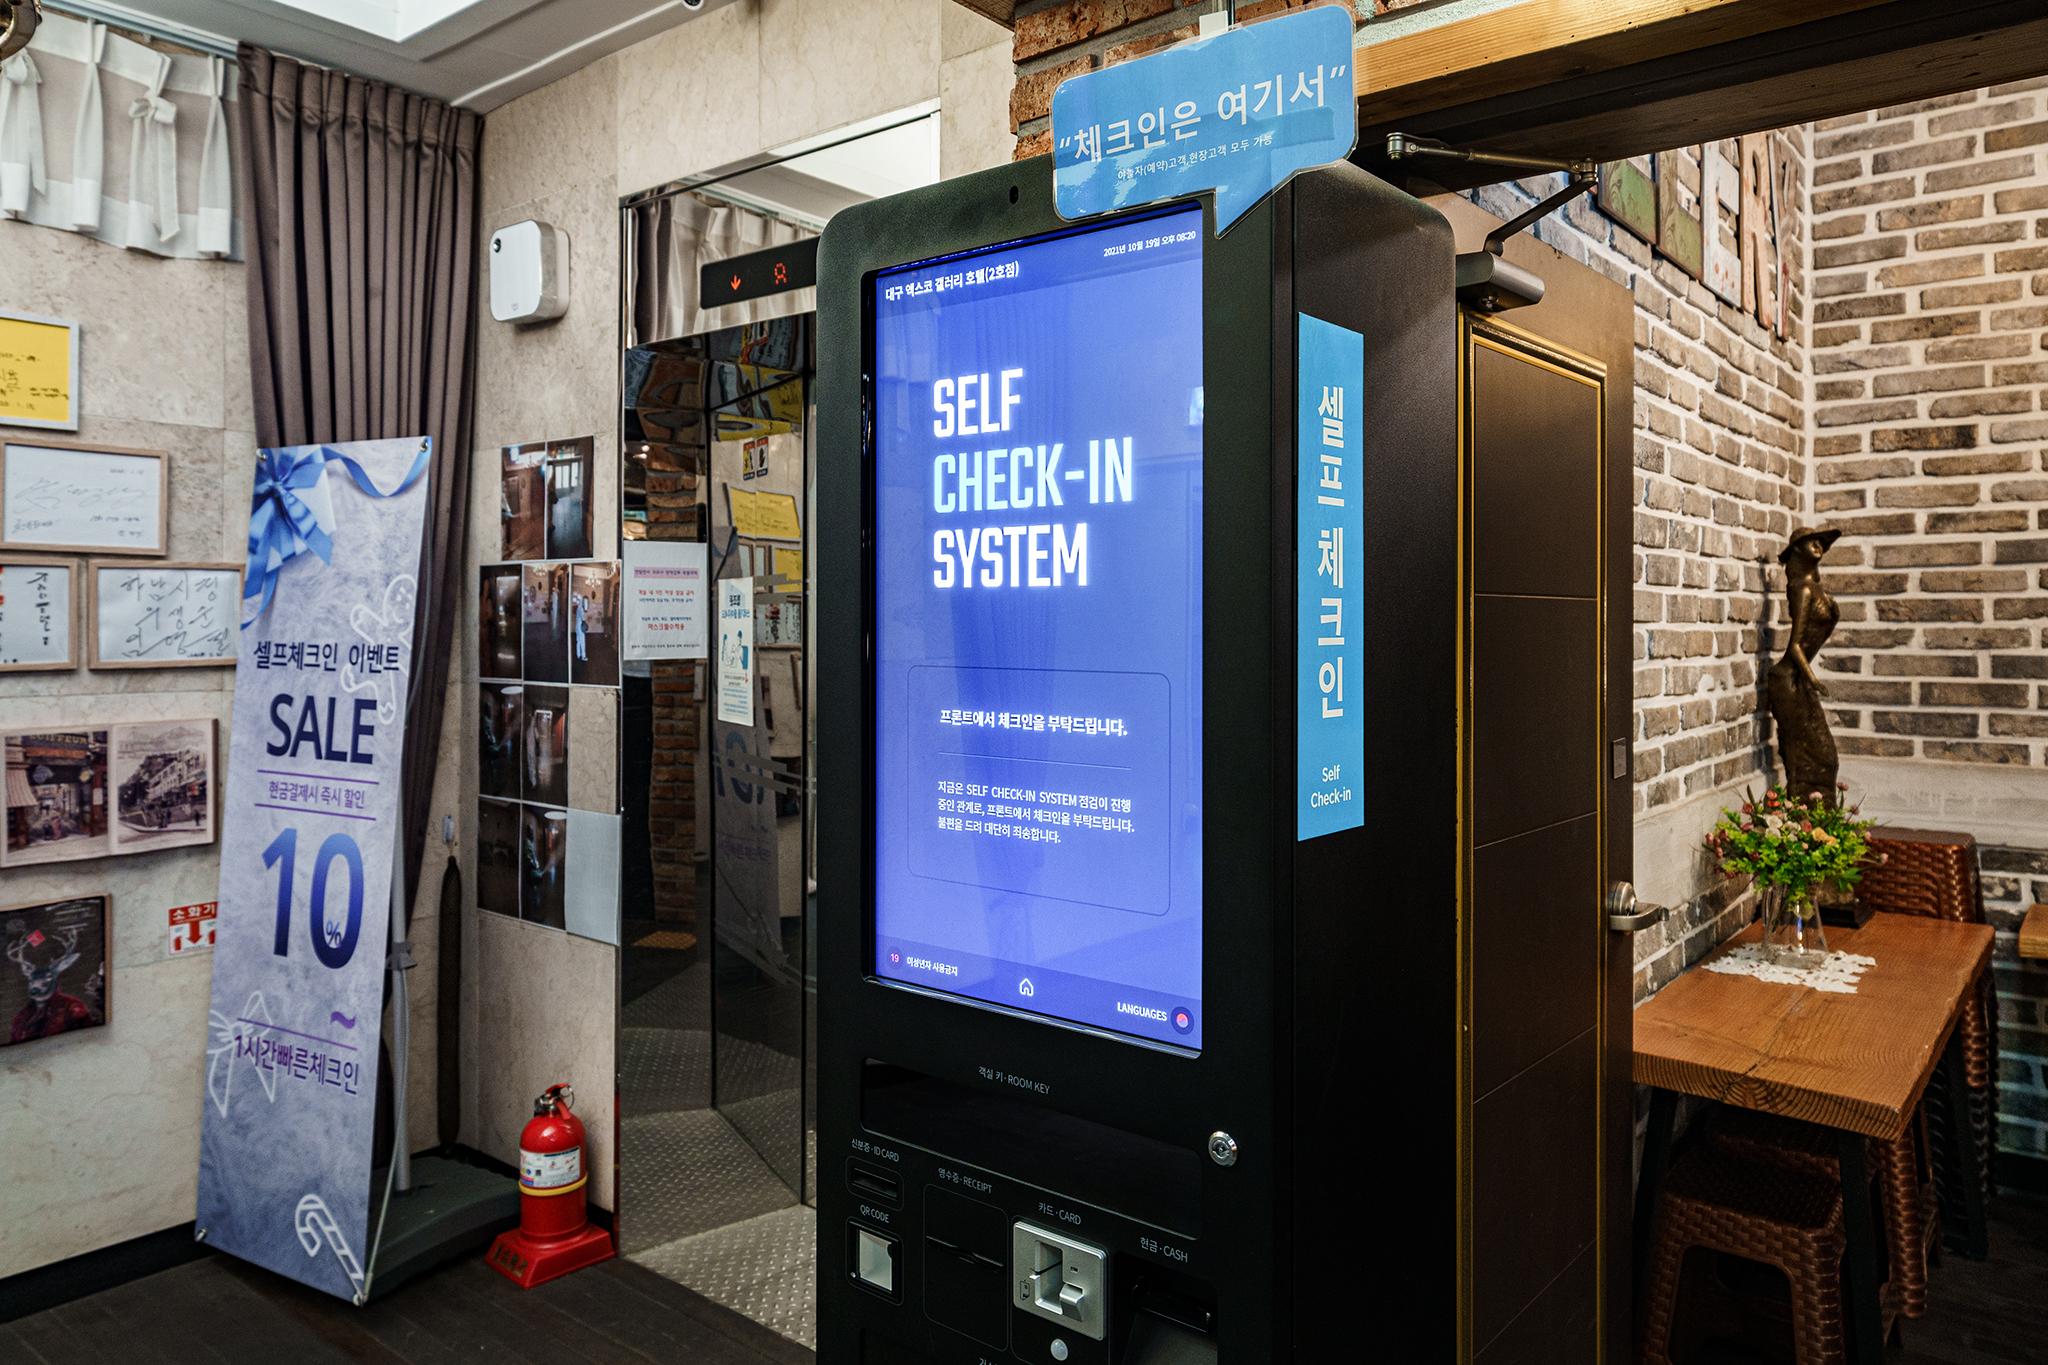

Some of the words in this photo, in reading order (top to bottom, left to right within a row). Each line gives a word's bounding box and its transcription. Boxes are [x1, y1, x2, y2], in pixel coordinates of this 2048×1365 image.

[1230, 139, 1249, 154] 모두
[1253, 134, 1273, 147] 가능
[1104, 244, 1126, 257] 2021년
[1127, 241, 1143, 252] 10월
[1145, 237, 1160, 249] 19일
[1161, 234, 1175, 245] 오후
[1176, 231, 1196, 243] 08:20
[885, 285, 904, 301] 대구
[905, 280, 933, 297] 엑스코
[935, 273, 963, 292] 갤러리
[965, 260, 1020, 285] 호텔(2호점)
[933, 368, 1024, 438] SELF
[933, 436, 1133, 514] CHECK-IN
[933, 522, 1088, 588] SYSTEM
[254, 640, 338, 672] 셀프체크인
[349, 642, 399, 674] 이벤트
[266, 693, 377, 765] SALE
[940, 709, 995, 729] 프론트에서
[998, 712, 1045, 732] 체크인을
[1048, 715, 1129, 737] 부탁드립니다.
[1322, 764, 1340, 782] Self
[268, 780, 320, 804] 현금결제시
[320, 785, 343, 806] 즉시
[344, 789, 366, 810] 할인
[937, 781, 964, 795] 지금은
[966, 784, 988, 797] SELF
[991, 786, 1036, 802] CHECK-IN
[1039, 791, 1077, 807] SYSTEM
[1079, 795, 1108, 811] 점검이
[1110, 798, 1131, 813] 진행
[1311, 786, 1351, 808] Check-in
[938, 798, 955, 812] 중인
[956, 801, 985, 817] 관계로,
[987, 804, 1031, 821] 프론트에서
[1033, 809, 1071, 826] 체크인을
[1073, 813, 1135, 833] 부탁드립니다.
[938, 817, 963, 831] 불편을
[965, 820, 982, 834] 드려
[984, 822, 1010, 838] 대단히
[1013, 825, 1062, 843] 죄송합니다.
[172, 904, 216, 920] 소화기
[261, 827, 364, 969] 10
[891, 953, 899, 962] 19
[933, 962, 958, 976] 사용금지
[1117, 1001, 1167, 1022] LANGUAGES
[234, 1034, 359, 1095] 1시간빠른체크인
[979, 1066, 993, 1080] 객실
[1034, 1081, 1050, 1094] KEY
[881, 1148, 899, 1162] CARD
[860, 1204, 870, 1216] QR
[870, 1208, 890, 1223] CODE
